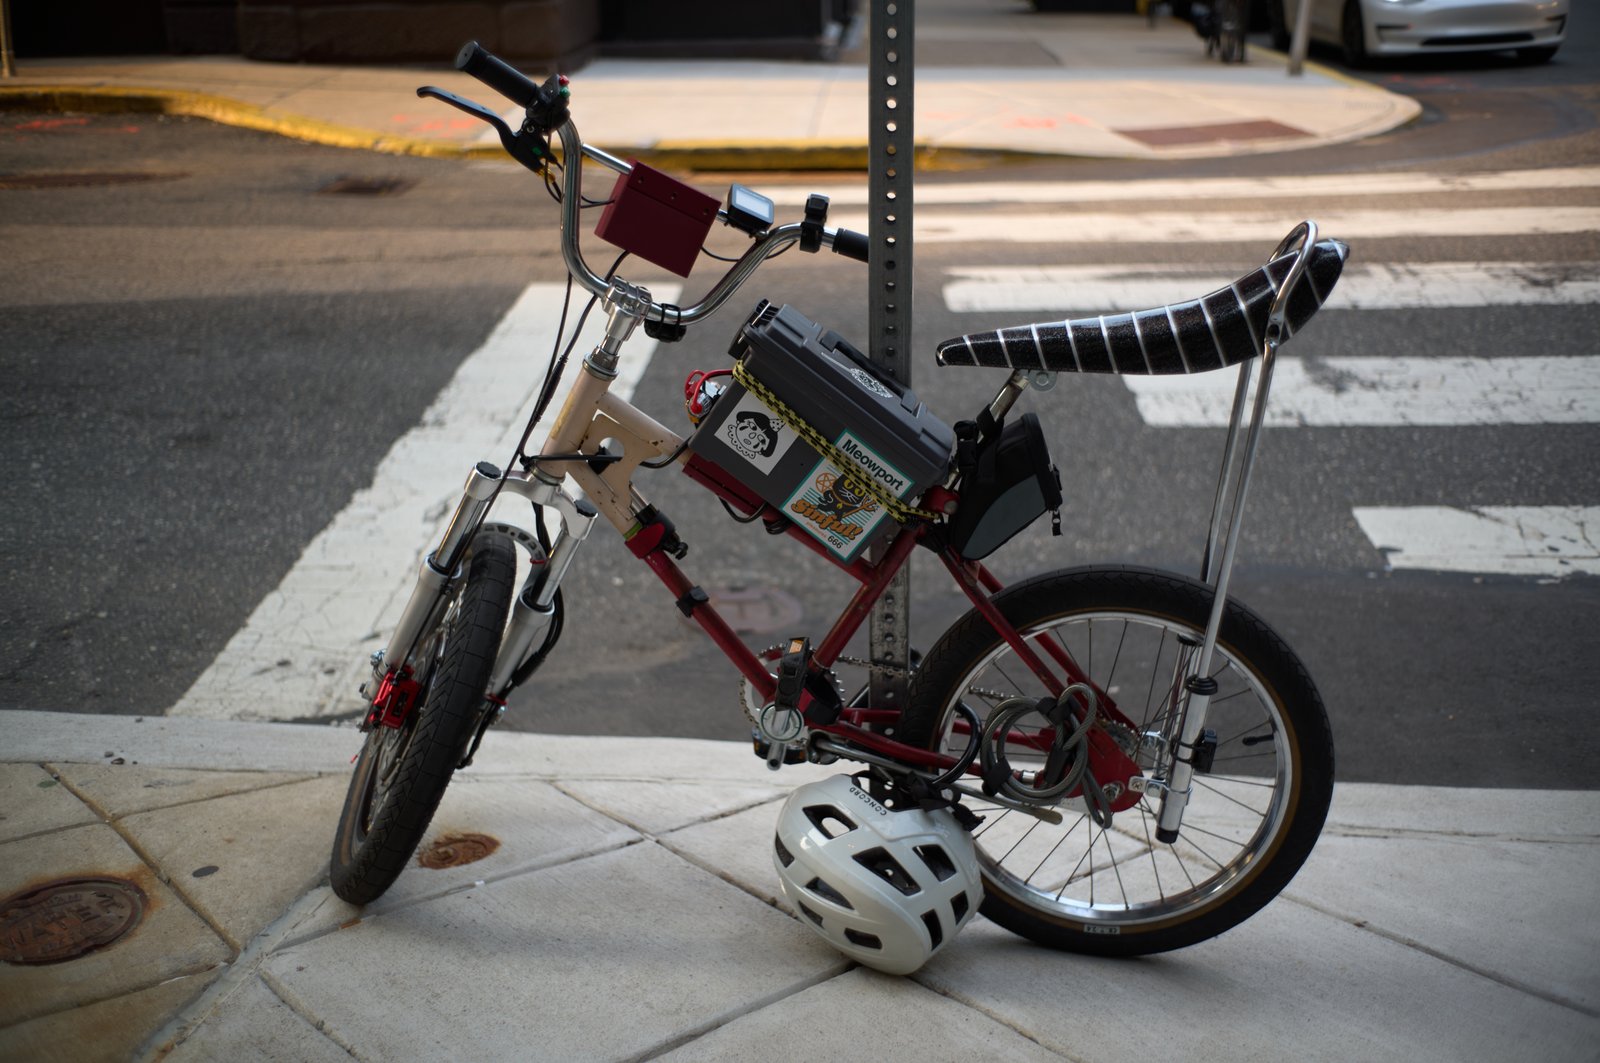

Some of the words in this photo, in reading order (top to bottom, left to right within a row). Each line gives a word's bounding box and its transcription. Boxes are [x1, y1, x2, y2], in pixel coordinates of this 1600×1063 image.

[842, 439, 904, 491] Meowport
[791, 499, 863, 540] Sinful!
[827, 535, 844, 549] 666
[849, 786, 887, 816] CONCORD
